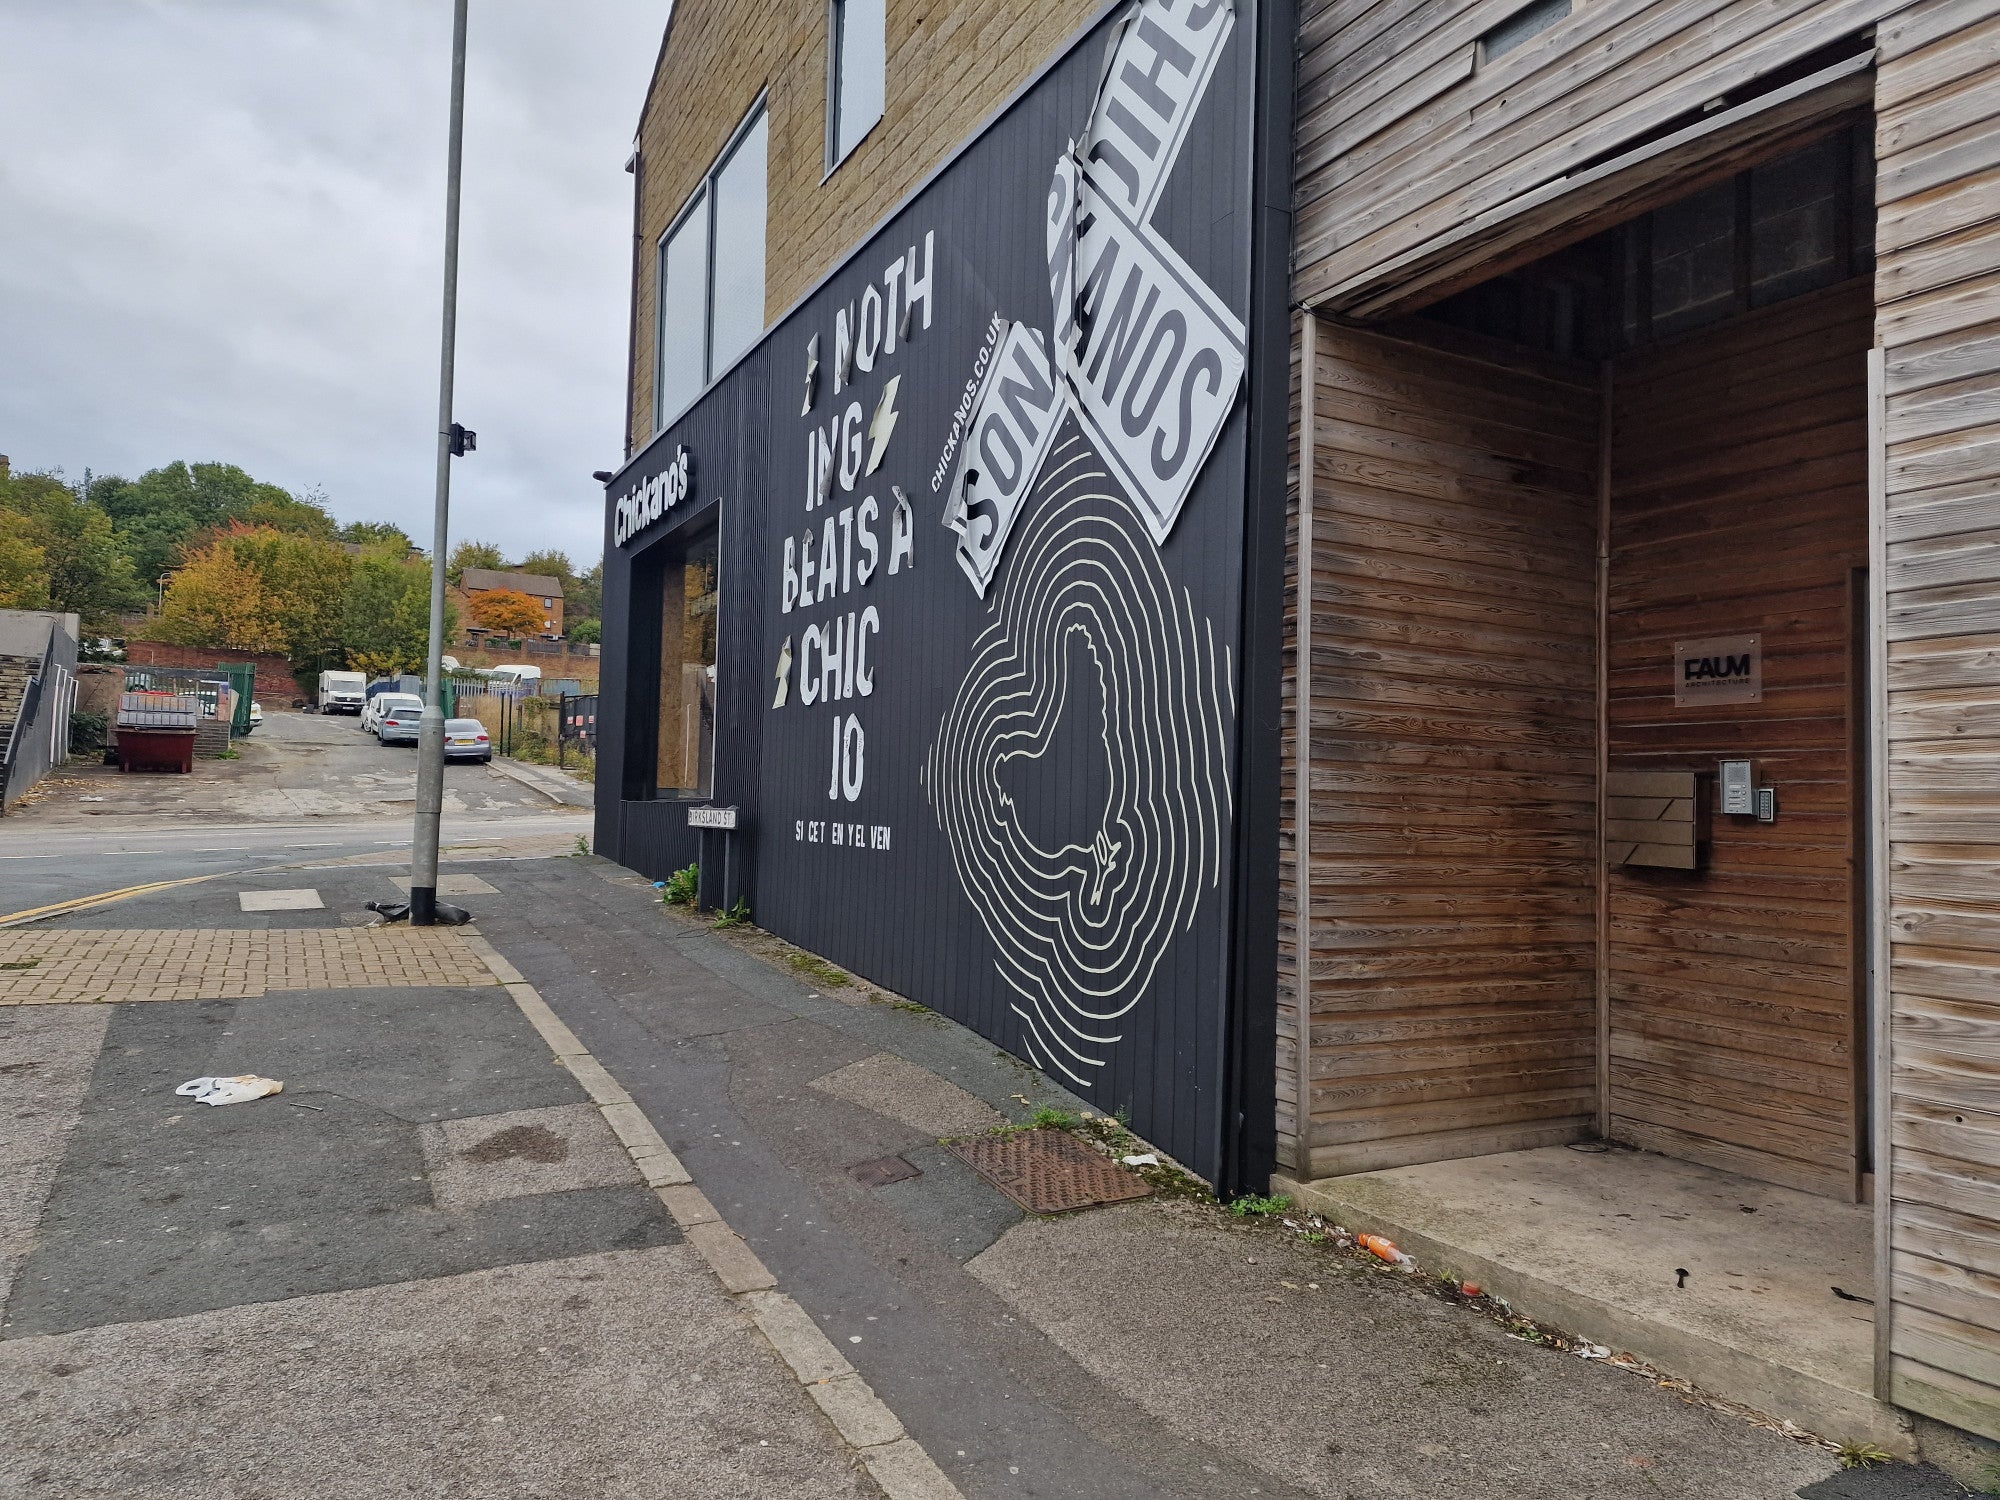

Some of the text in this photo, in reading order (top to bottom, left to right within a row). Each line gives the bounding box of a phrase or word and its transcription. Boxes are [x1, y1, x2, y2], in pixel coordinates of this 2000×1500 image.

[834, 229, 935, 396] NOTH
[931, 311, 1001, 493] CHICKANOS.CO.UK
[614, 444, 688, 548] Chickano's
[805, 401, 863, 512] ING
[782, 485, 914, 614] BEATS A
[800, 605, 880, 706] CHIC
[1684, 653, 1750, 680] FAUM
[1685, 678, 1750, 688] ARCHITECTURE
